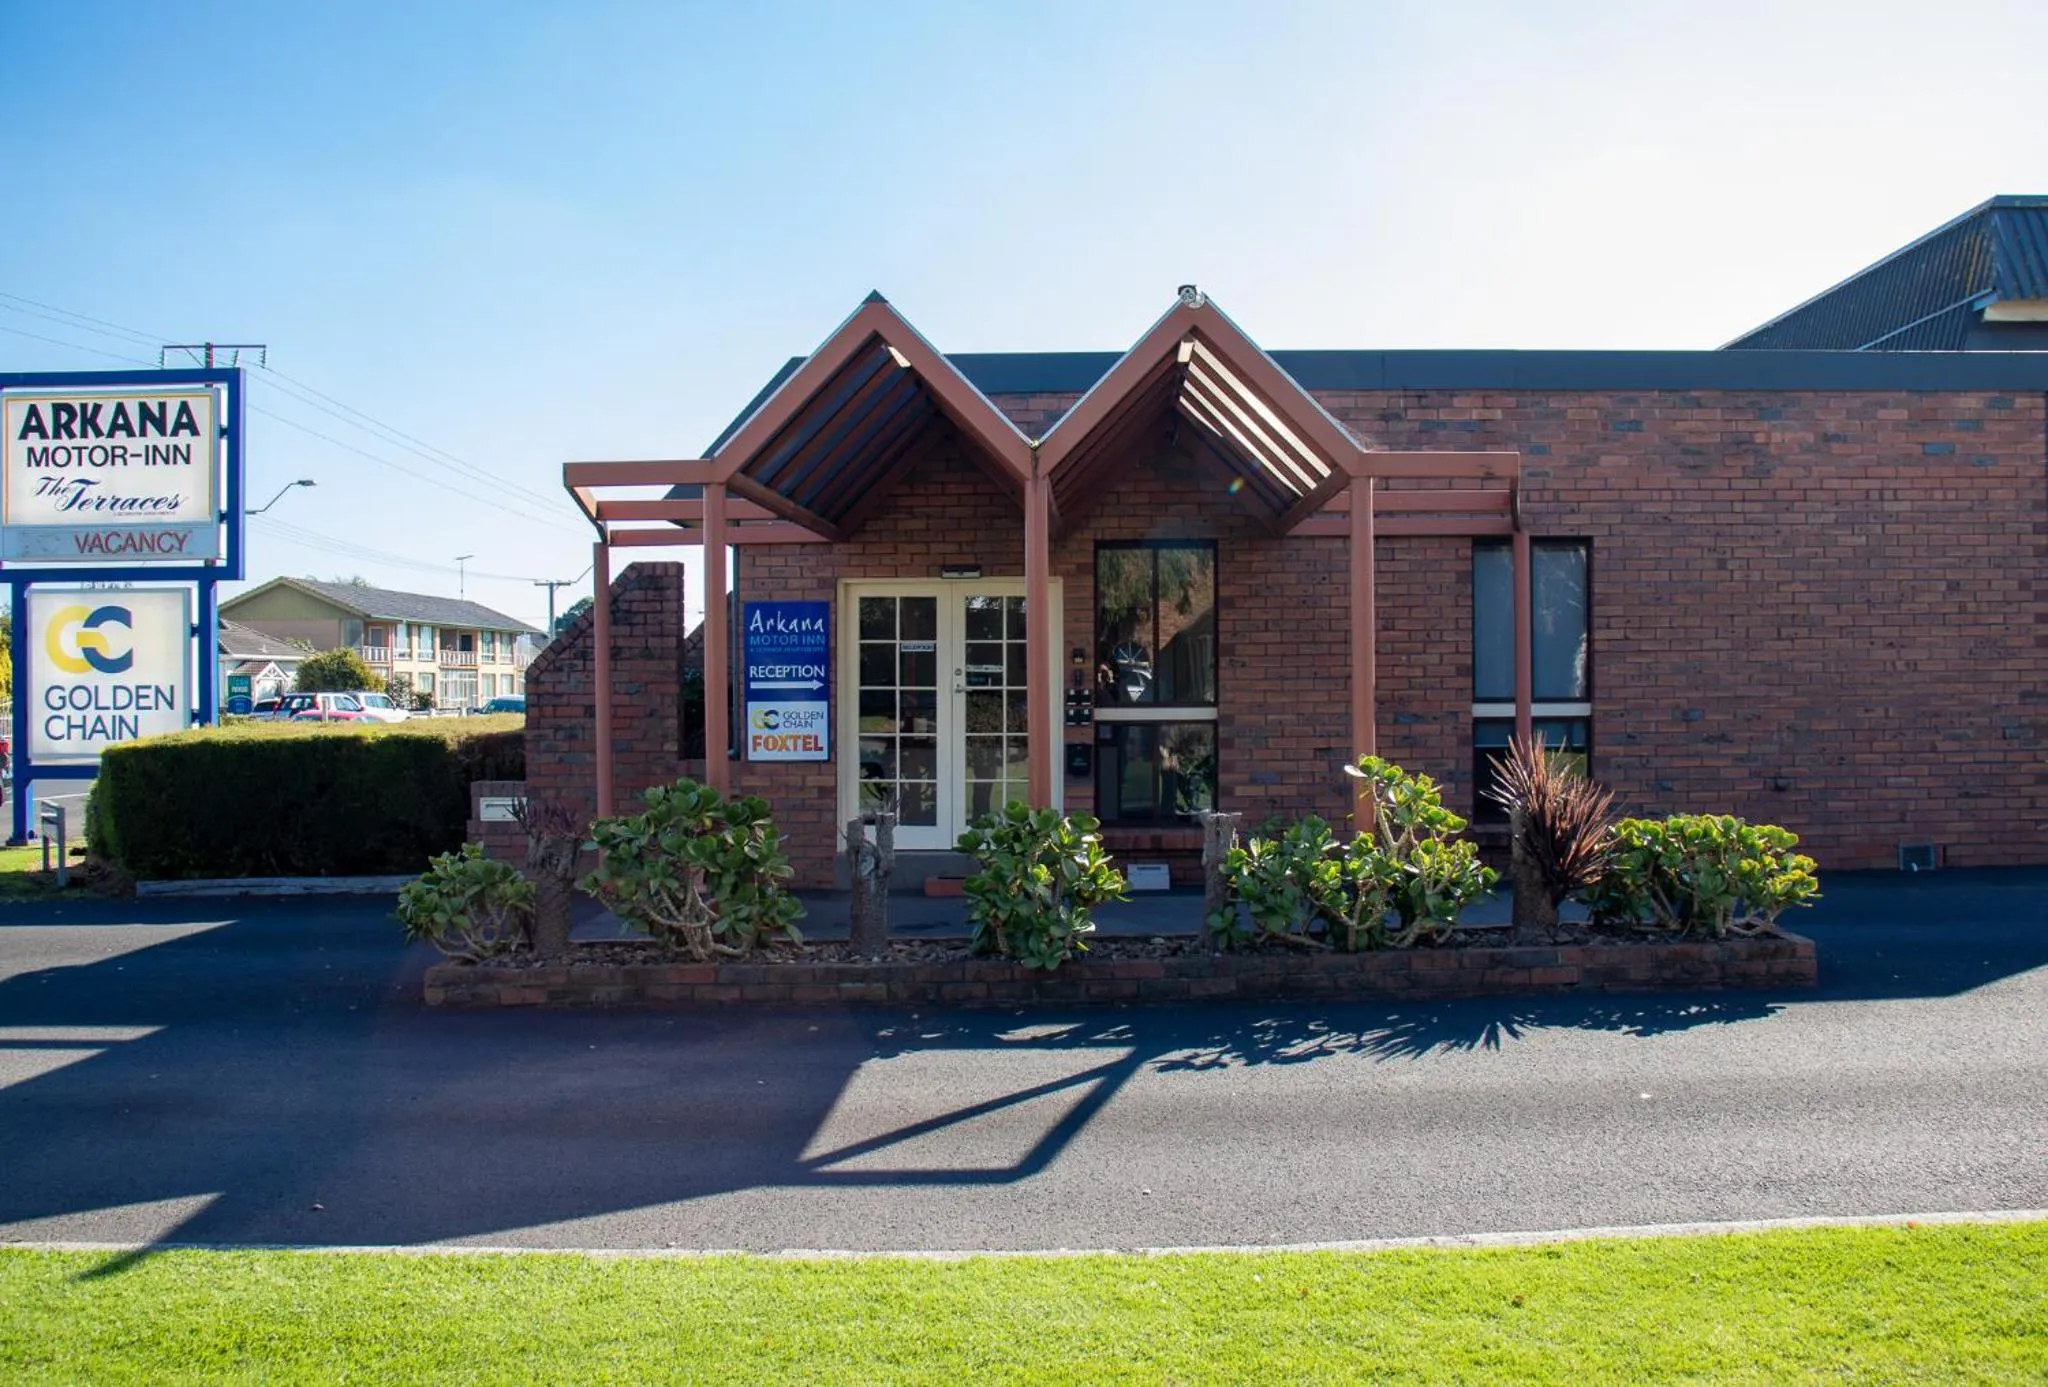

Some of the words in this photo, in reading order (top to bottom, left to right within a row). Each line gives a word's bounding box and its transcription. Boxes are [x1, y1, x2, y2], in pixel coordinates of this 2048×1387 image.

[18, 400, 201, 440] ARKANA
[27, 443, 192, 468] MOTOR-INN
[33, 476, 69, 497] The
[55, 478, 187, 512] Terraces
[74, 531, 192, 554] VACANCY
[750, 609, 824, 633] Arkana
[750, 634, 799, 646] MOTOR
[802, 634, 826, 646] INN
[750, 665, 825, 678] RECEPTION
[44, 685, 176, 711] GOLDEN
[783, 711, 824, 720] GOLDEN
[783, 720, 814, 729] CHAIN
[44, 715, 139, 741] CHAIN
[752, 734, 824, 752] FOXTEL
